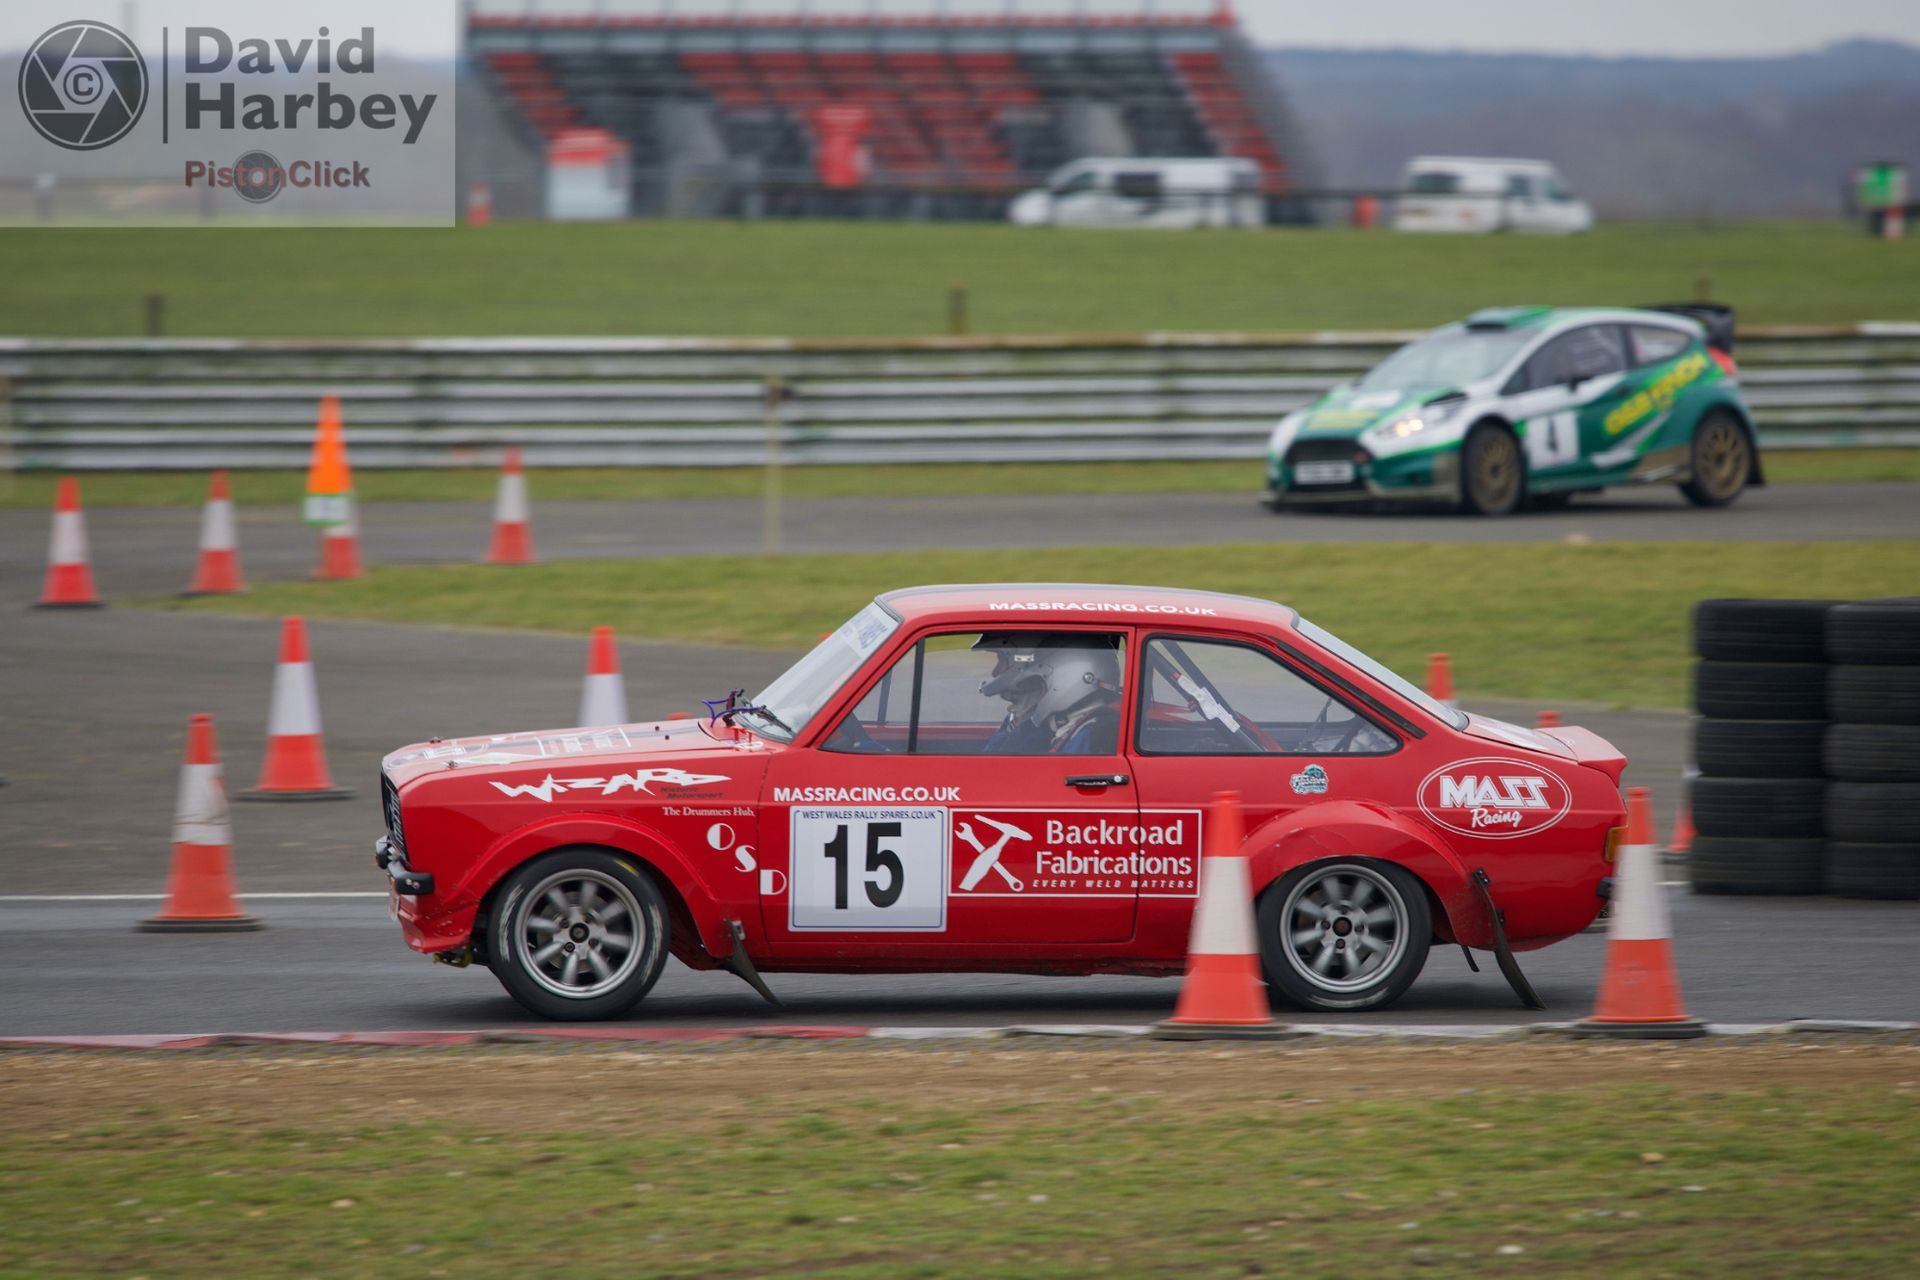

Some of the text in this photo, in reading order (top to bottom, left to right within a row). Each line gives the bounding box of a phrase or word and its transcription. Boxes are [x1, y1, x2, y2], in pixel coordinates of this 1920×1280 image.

[989, 602, 1217, 616] MASSRACING.CO.UK
[773, 786, 961, 802] MASSRACING.CO.UK
[1439, 775, 1551, 809] MASS
[662, 806, 681, 817] The
[683, 806, 731, 817] Drummers
[802, 810, 936, 820] WEST WALES RALLY SPARES.CO.UK
[1471, 808, 1523, 828] Racing
[1046, 819, 1183, 845] Backroad
[823, 821, 905, 911] 15
[1036, 850, 1193, 875] Fabrications
[1032, 879, 1195, 889] EVERY WELD MATTERS
